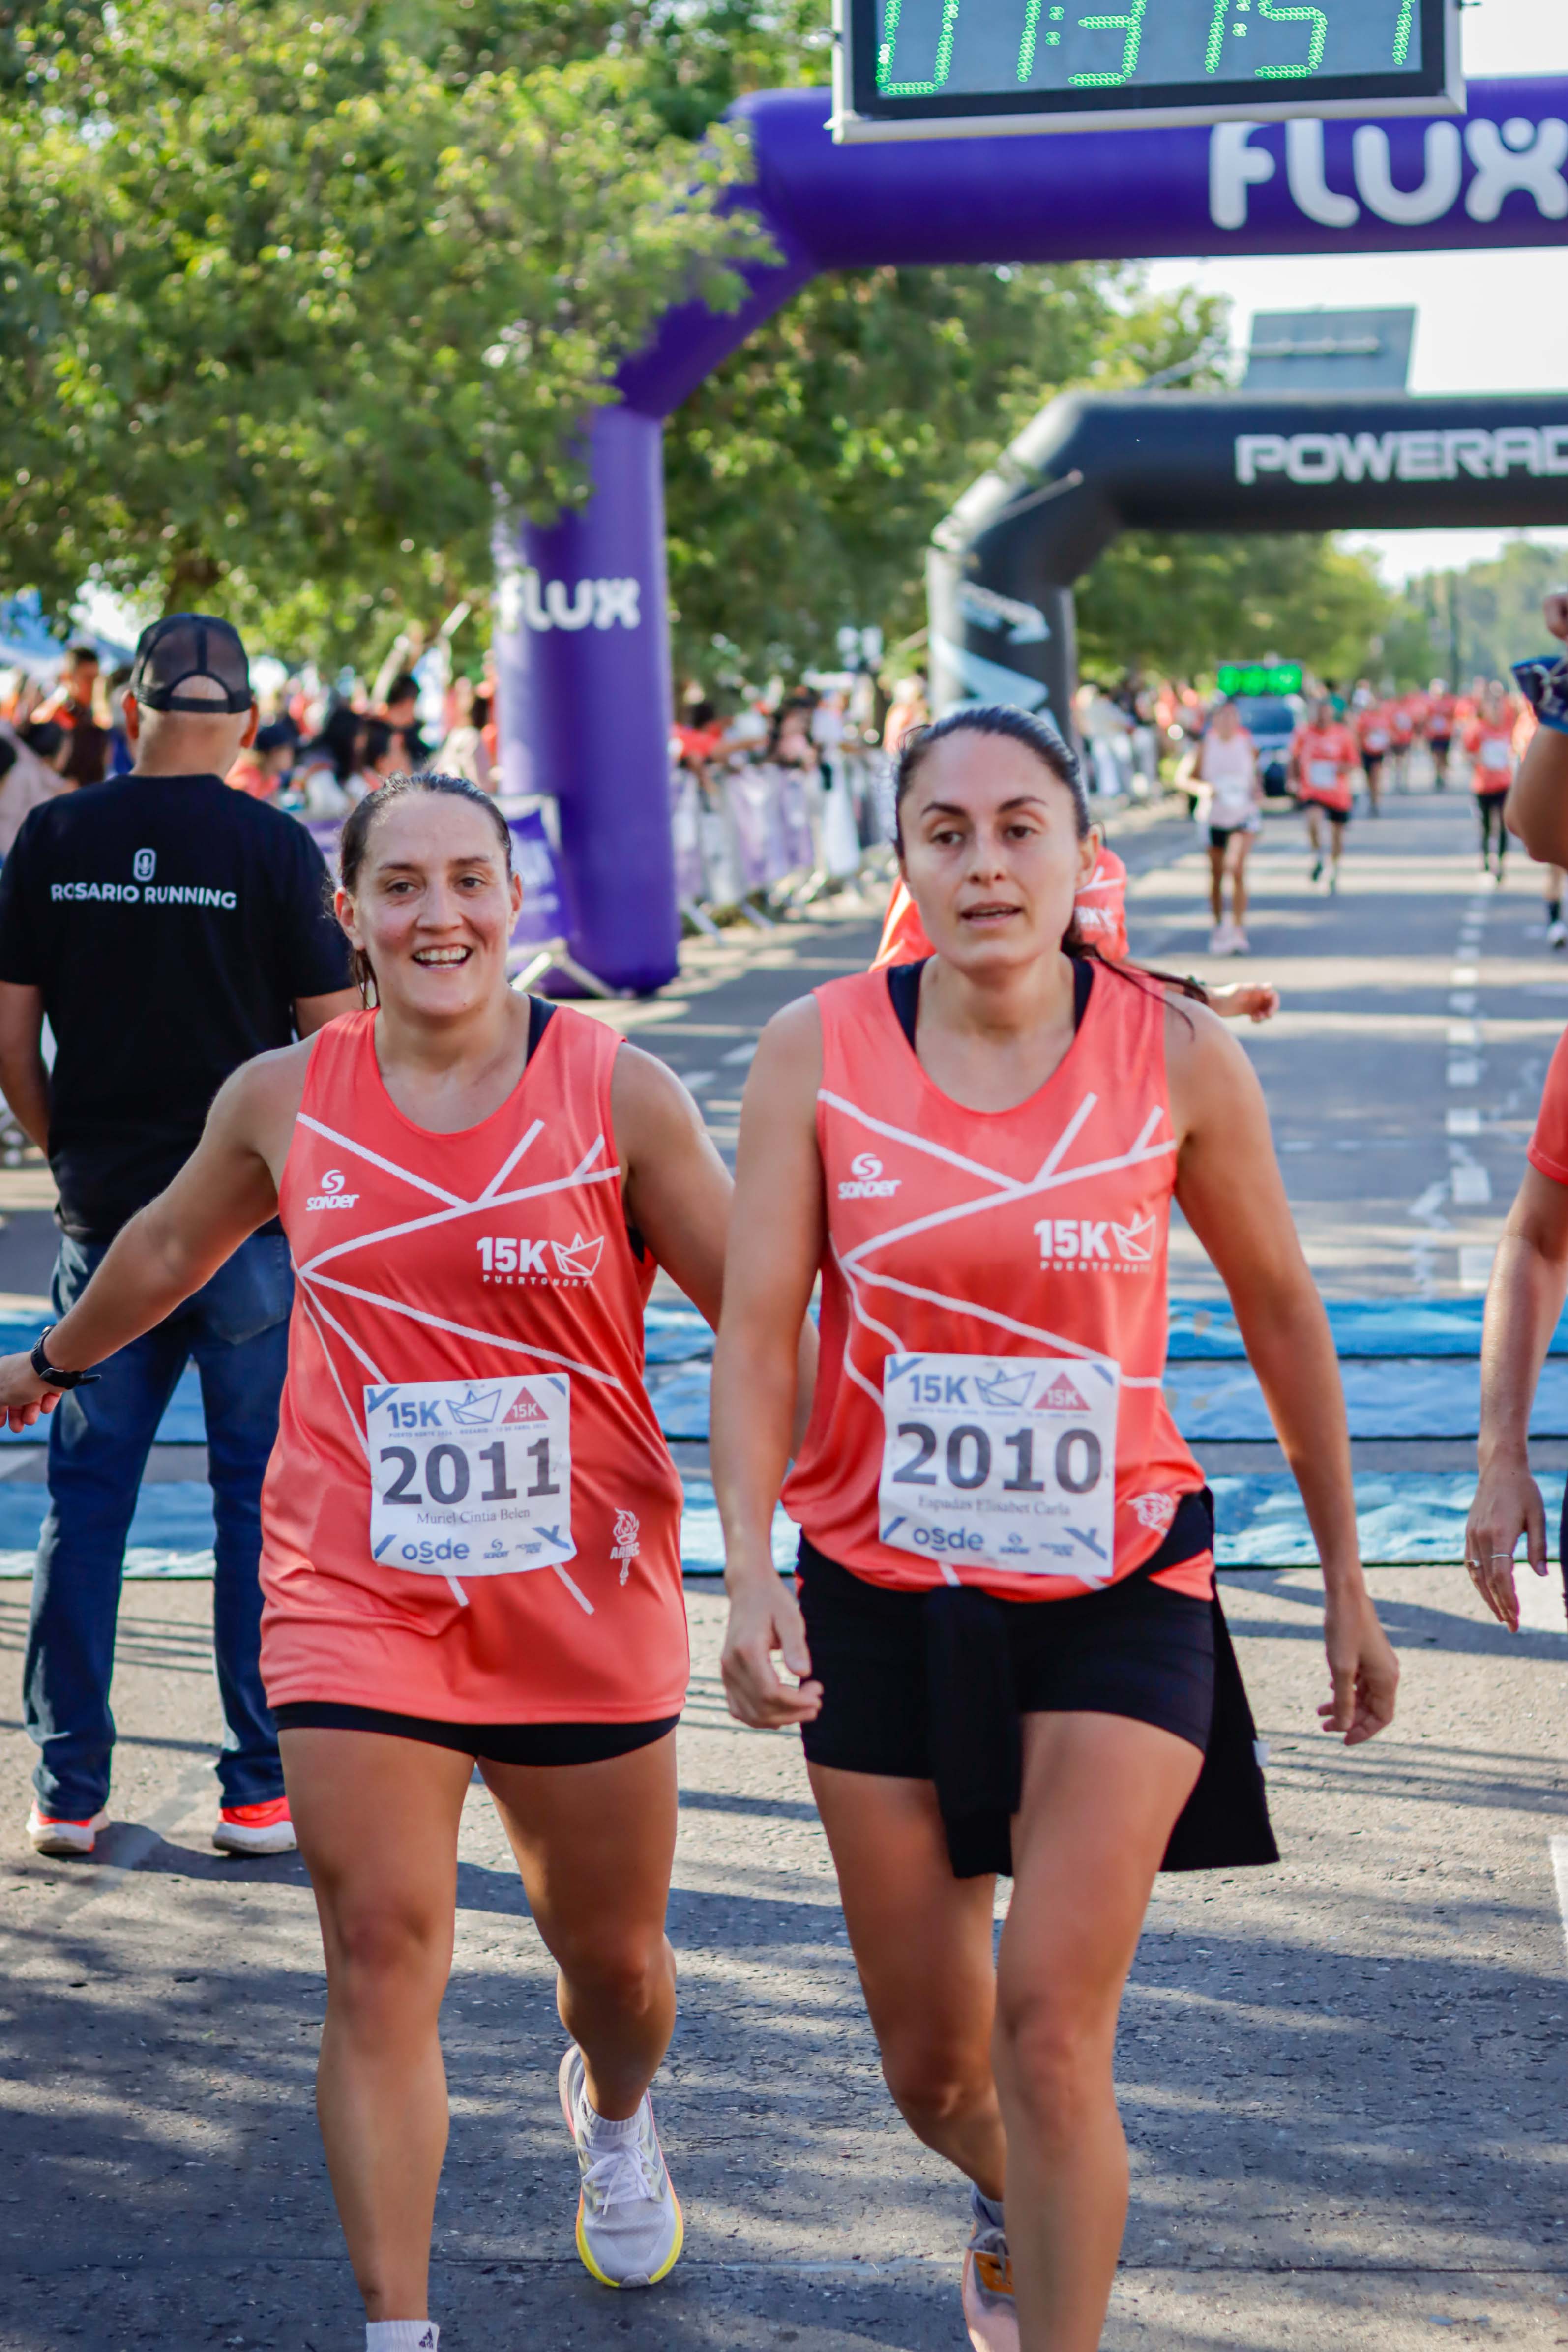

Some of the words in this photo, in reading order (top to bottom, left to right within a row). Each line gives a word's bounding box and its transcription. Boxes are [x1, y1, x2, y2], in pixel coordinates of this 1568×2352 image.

[1208, 117, 1568, 230] FLUX
[145, 886, 237, 909] RUNNING
[1034, 1219, 1110, 1259] 15K
[476, 1236, 548, 1273] 15K
[908, 1373, 968, 1404] 15K
[1045, 1388, 1079, 1405] 15K
[387, 1400, 442, 1428] 15K
[512, 1403, 538, 1417] 15K
[380, 1437, 560, 1505] 2011
[892, 1422, 1101, 1494] 2010
[416, 1512, 457, 1525] Muriel
[460, 1510, 497, 1524] Cintia
[500, 1507, 531, 1521] Belen
[401, 1538, 470, 1564] osde
[913, 1526, 985, 1552] osde
